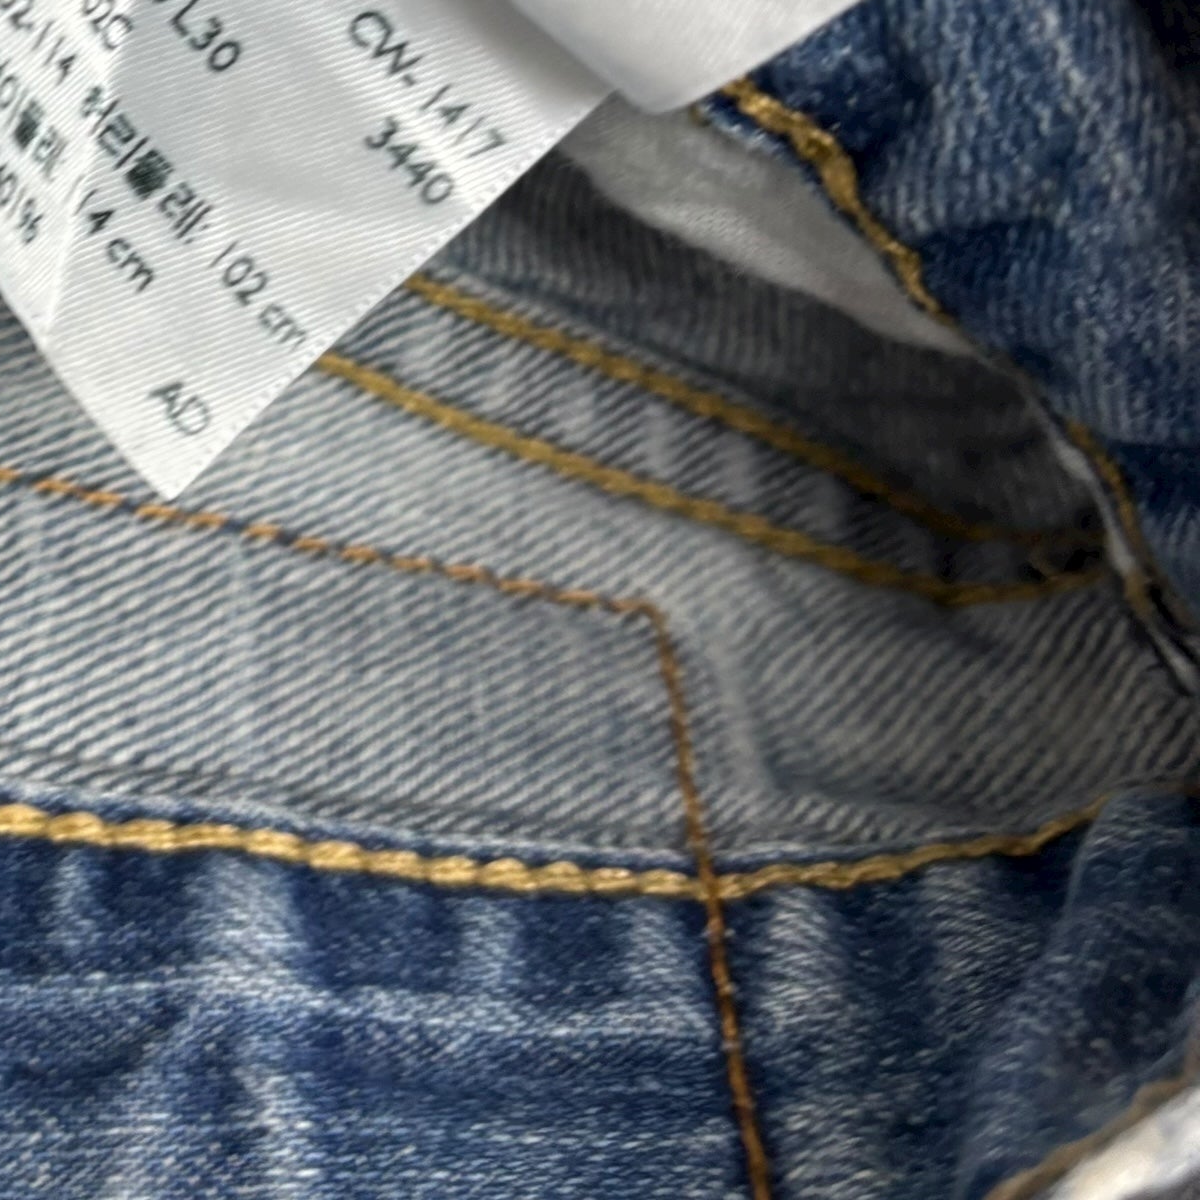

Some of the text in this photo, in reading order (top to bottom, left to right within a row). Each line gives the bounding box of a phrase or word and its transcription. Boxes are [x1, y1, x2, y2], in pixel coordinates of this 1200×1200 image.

[345, 7, 508, 163] CW- 1417
[362, 115, 457, 209] 3440
[104, 236, 157, 294] cm
[208, 240, 272, 308] 102
[256, 301, 309, 352] cm
[146, 379, 215, 440] AD
